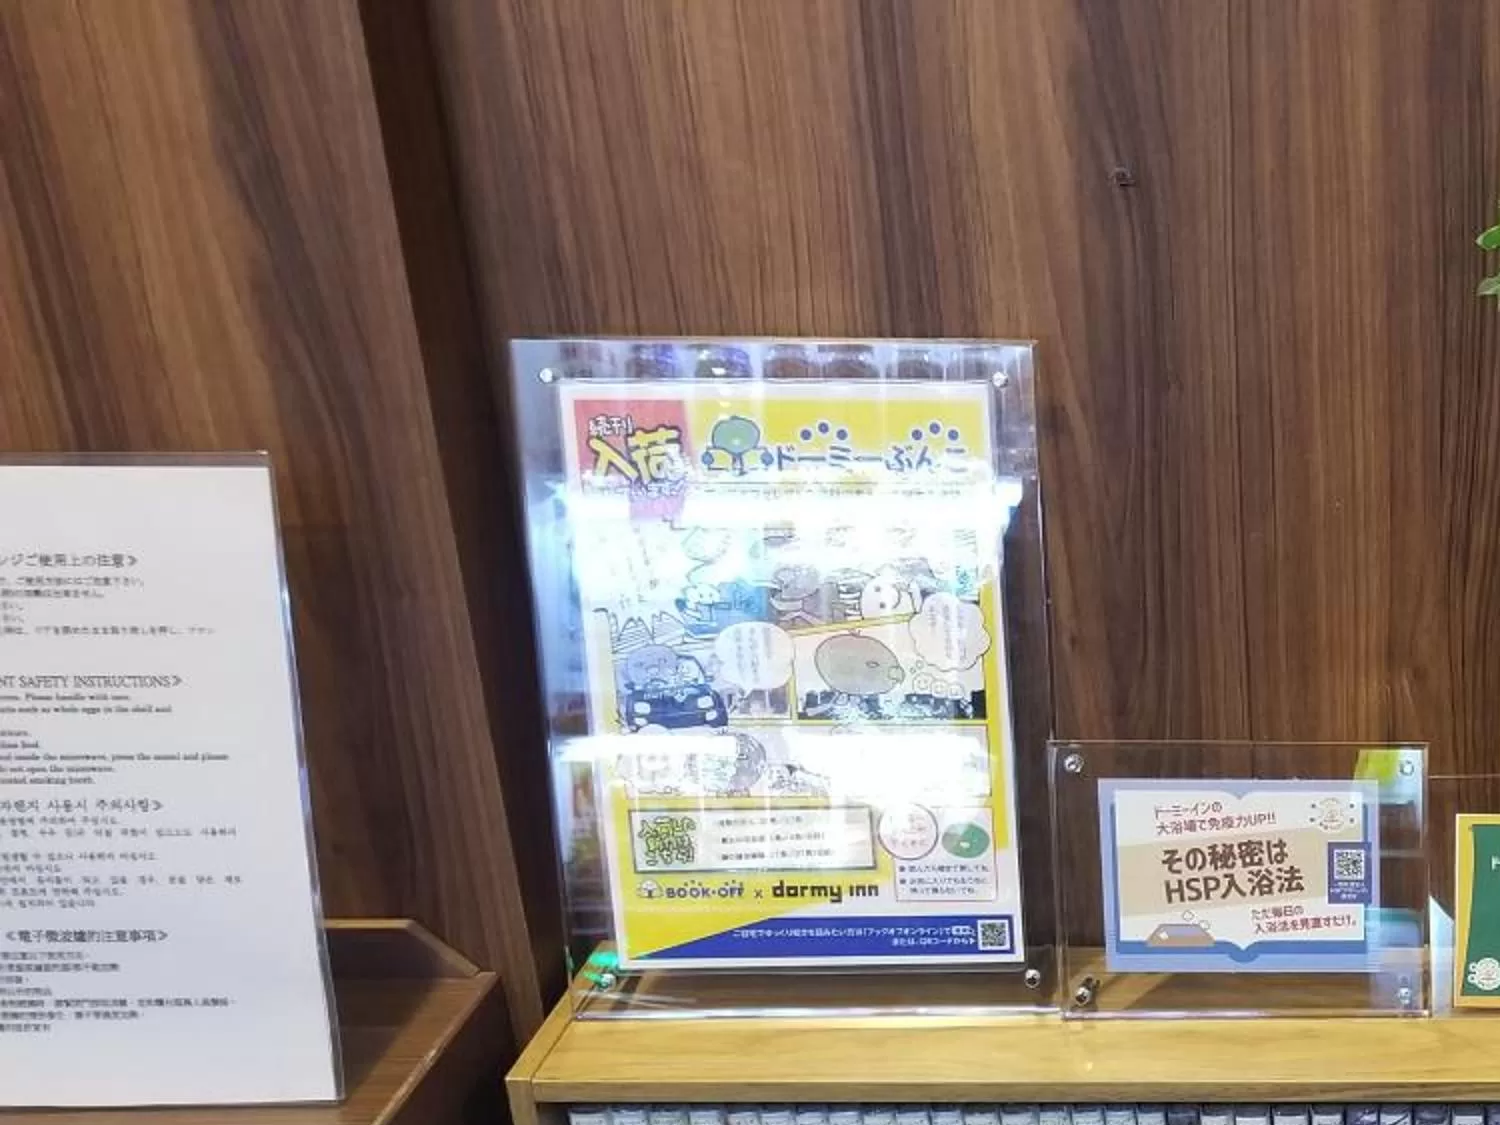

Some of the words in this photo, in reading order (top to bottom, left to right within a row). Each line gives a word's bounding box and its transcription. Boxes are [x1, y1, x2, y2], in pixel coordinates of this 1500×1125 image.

[19, 676, 69, 688] SAFETY
[1162, 838, 1288, 874] その秘密は
[772, 880, 842, 902] dormy
[1164, 866, 1305, 904] HSP入浴法
